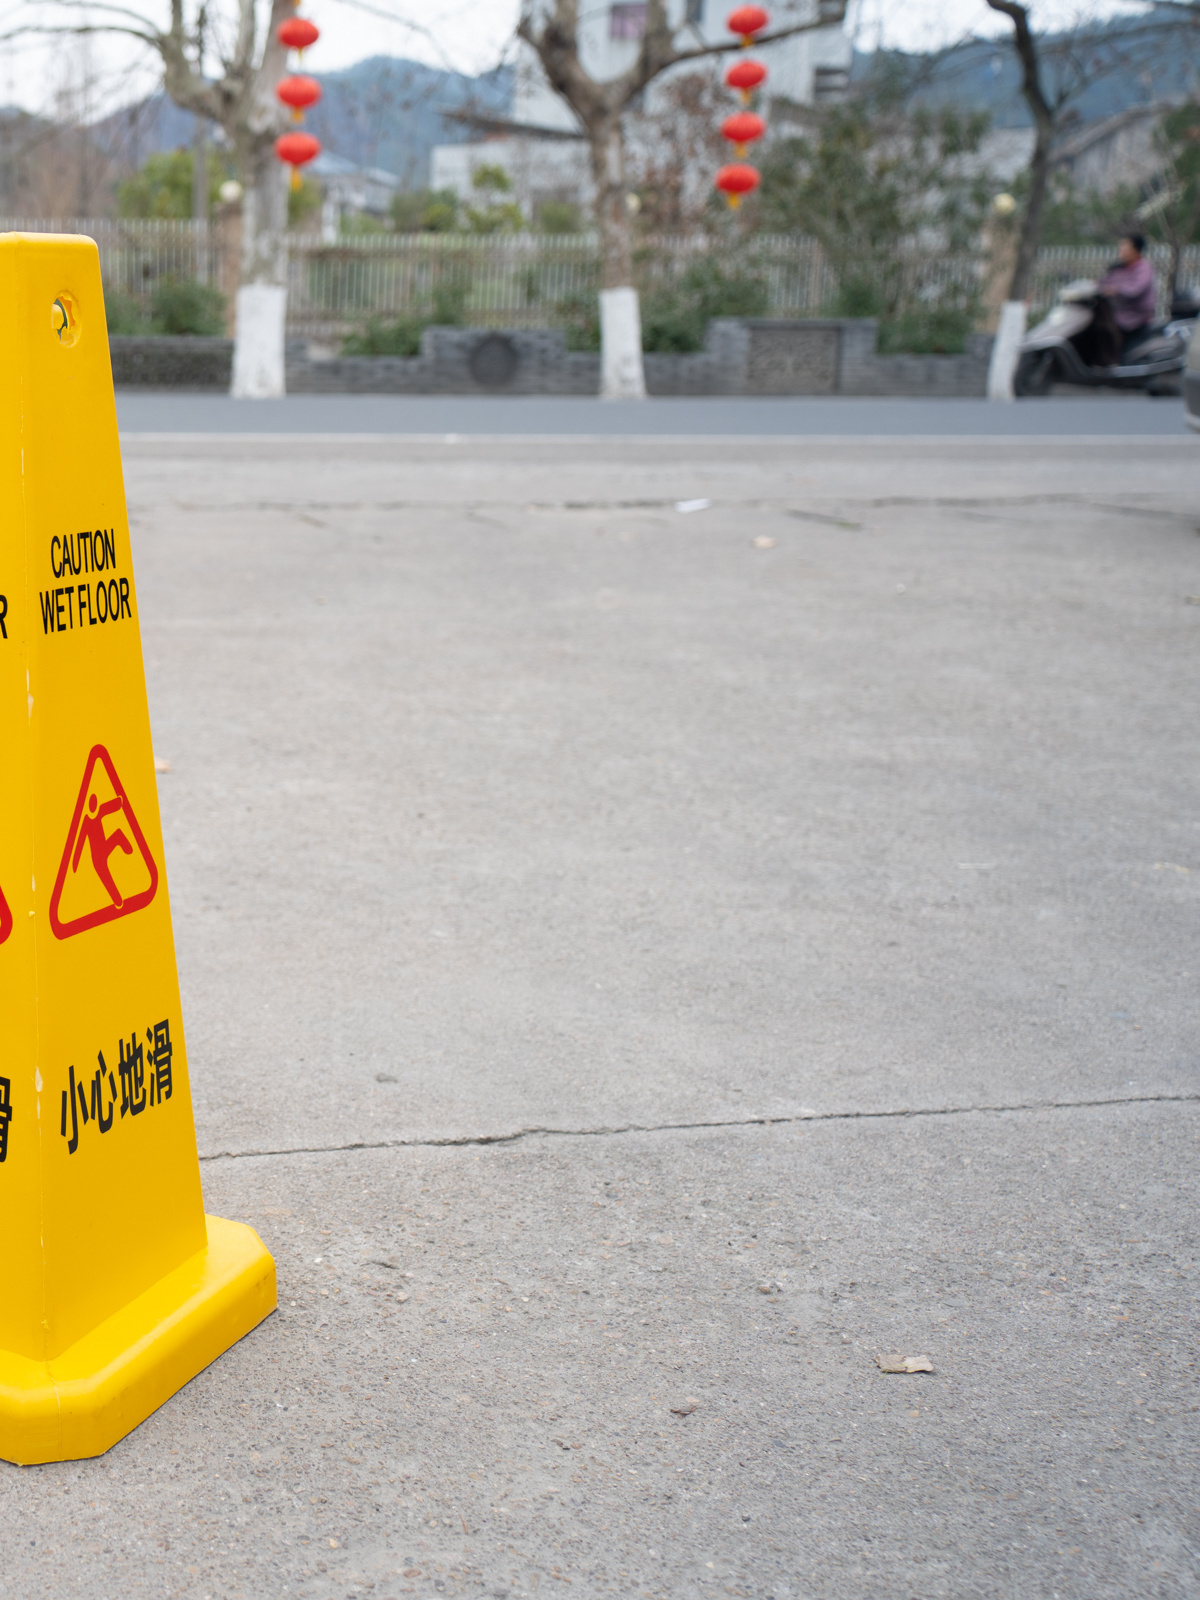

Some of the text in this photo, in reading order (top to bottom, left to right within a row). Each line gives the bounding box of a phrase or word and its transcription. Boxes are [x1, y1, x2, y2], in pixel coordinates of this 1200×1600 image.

[50, 528, 116, 579] CAUTION
[39, 577, 132, 635] WET FLOOR
[60, 1018, 173, 1155] 小心地滑
